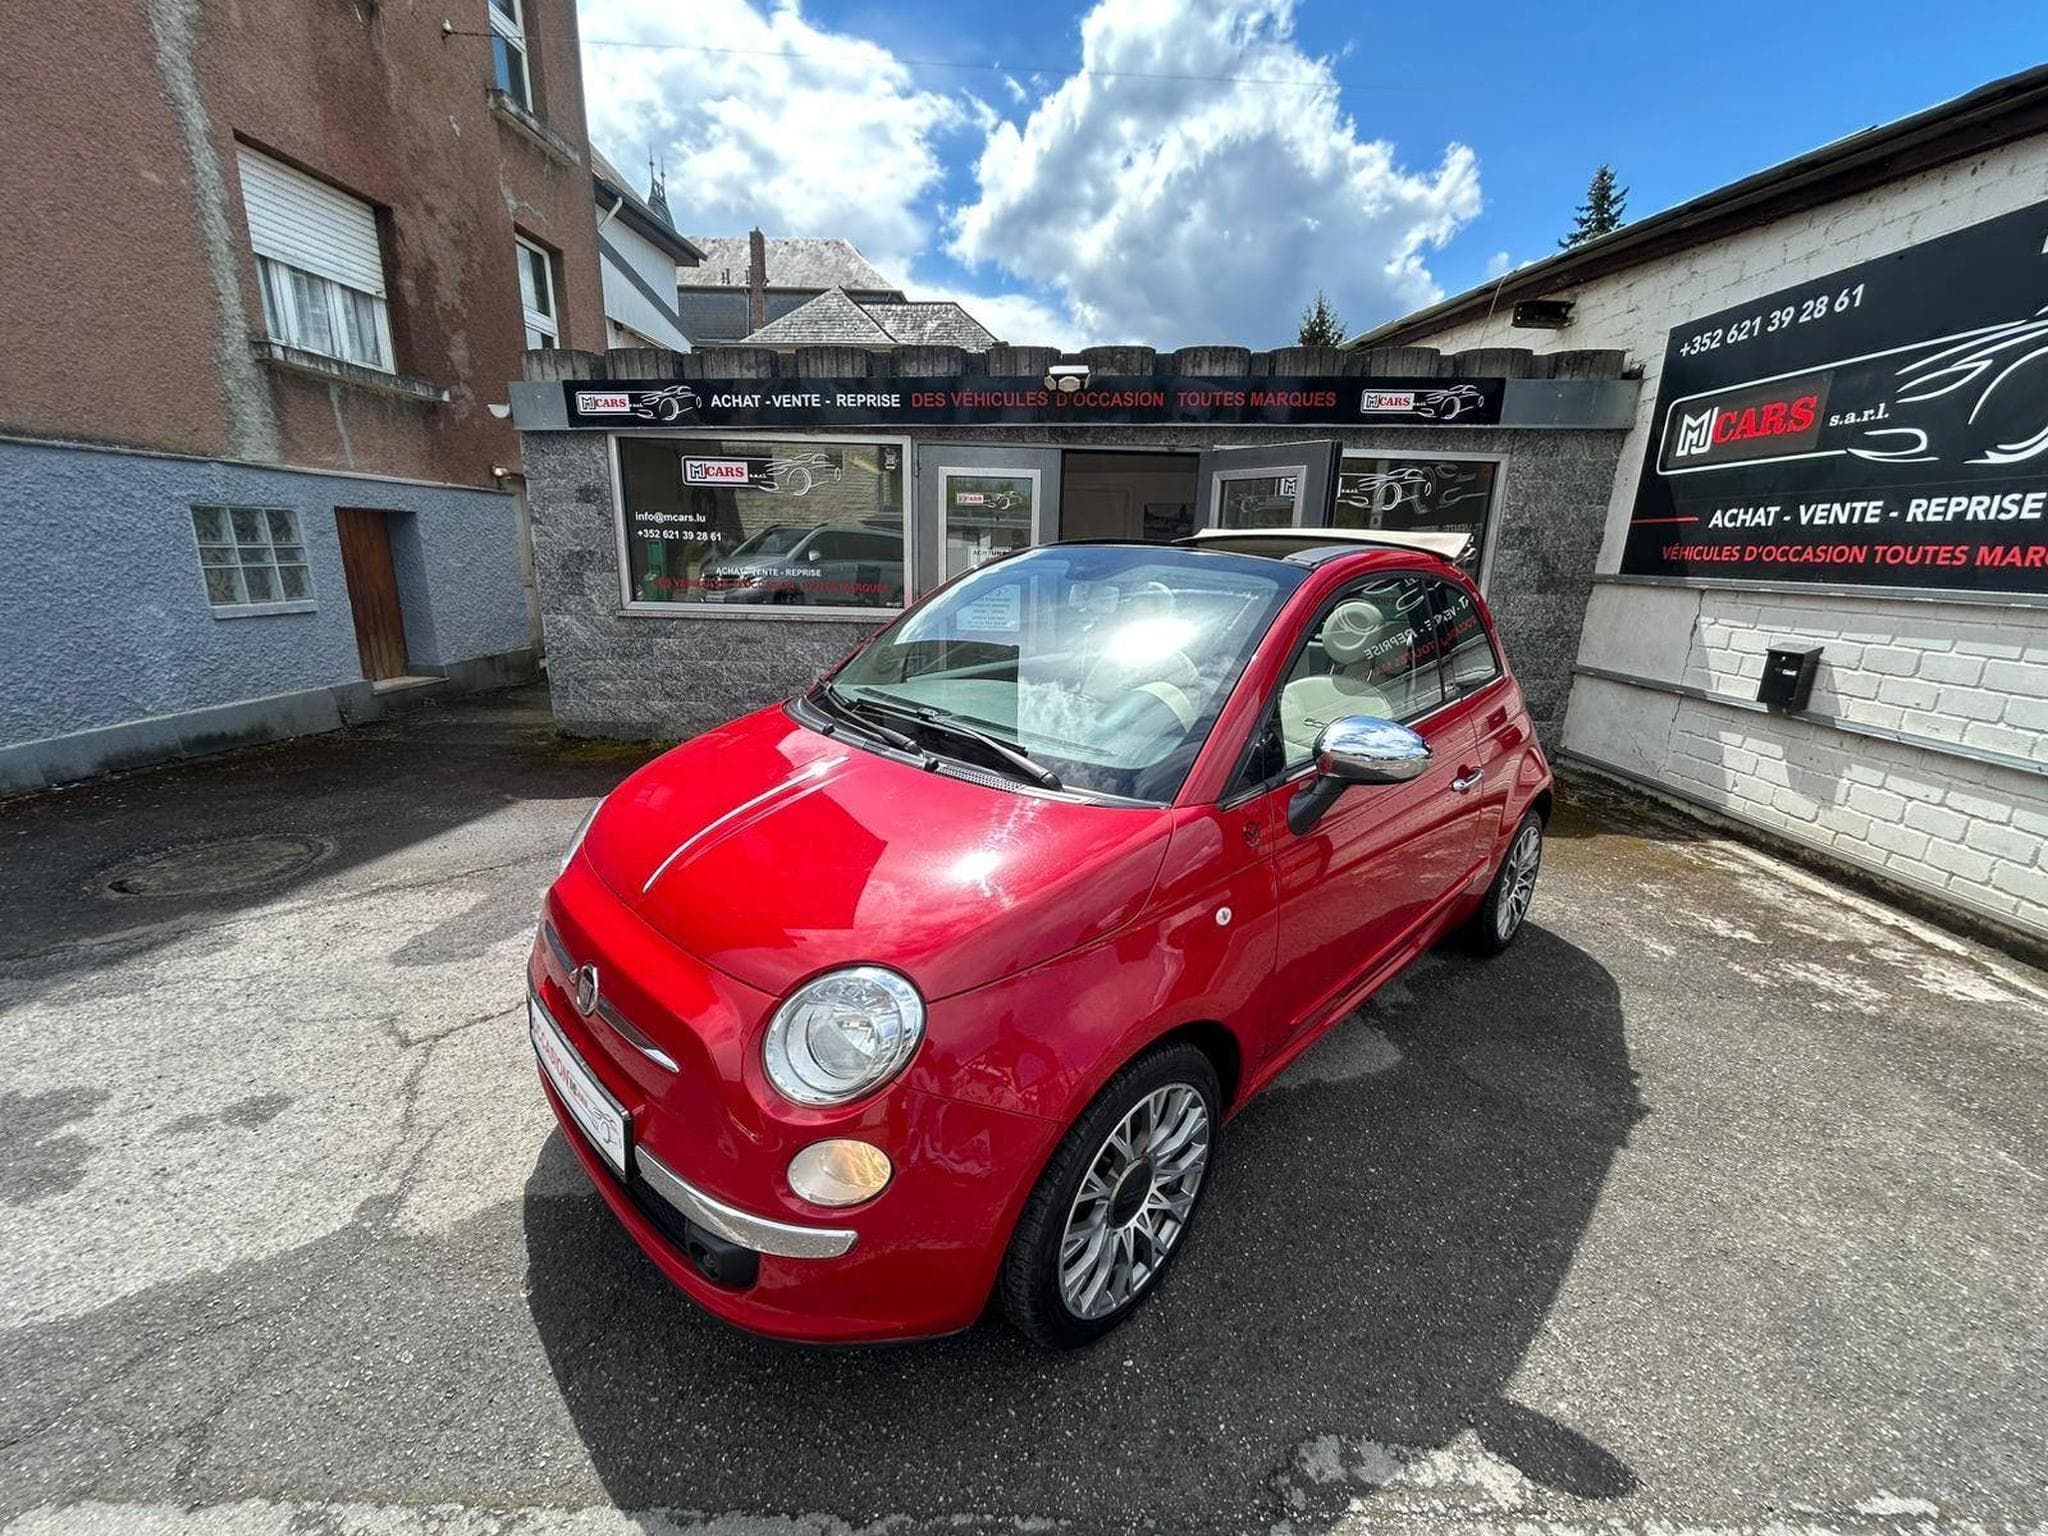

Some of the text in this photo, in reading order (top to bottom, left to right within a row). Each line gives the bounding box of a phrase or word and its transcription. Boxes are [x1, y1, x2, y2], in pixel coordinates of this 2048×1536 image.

[1679, 283, 1865, 357] +352 621 39 28 61
[711, 394, 761, 407] ACHAT
[771, 394, 821, 407] VENTE
[836, 394, 901, 407] REPRISE
[911, 392, 945, 407] DES
[950, 387, 1048, 407] VÉHICULES
[1056, 392, 1164, 407] D'OCCASION
[1177, 392, 1246, 407] TOUTES
[1250, 391, 1337, 407] MARQUES
[1829, 403, 1890, 427] s.a.r.l.
[635, 511, 706, 524] info@mcars.lu
[1708, 506, 1781, 529] ACHAT
[1799, 501, 1884, 525] VENTE
[1905, 492, 2047, 523] REPRISE
[637, 529, 721, 542] +352 621 39 28 61
[1662, 543, 2048, 567] VÉHICULES D'OCCASION TOUTES MAR
[785, 568, 822, 577] REPRISE
